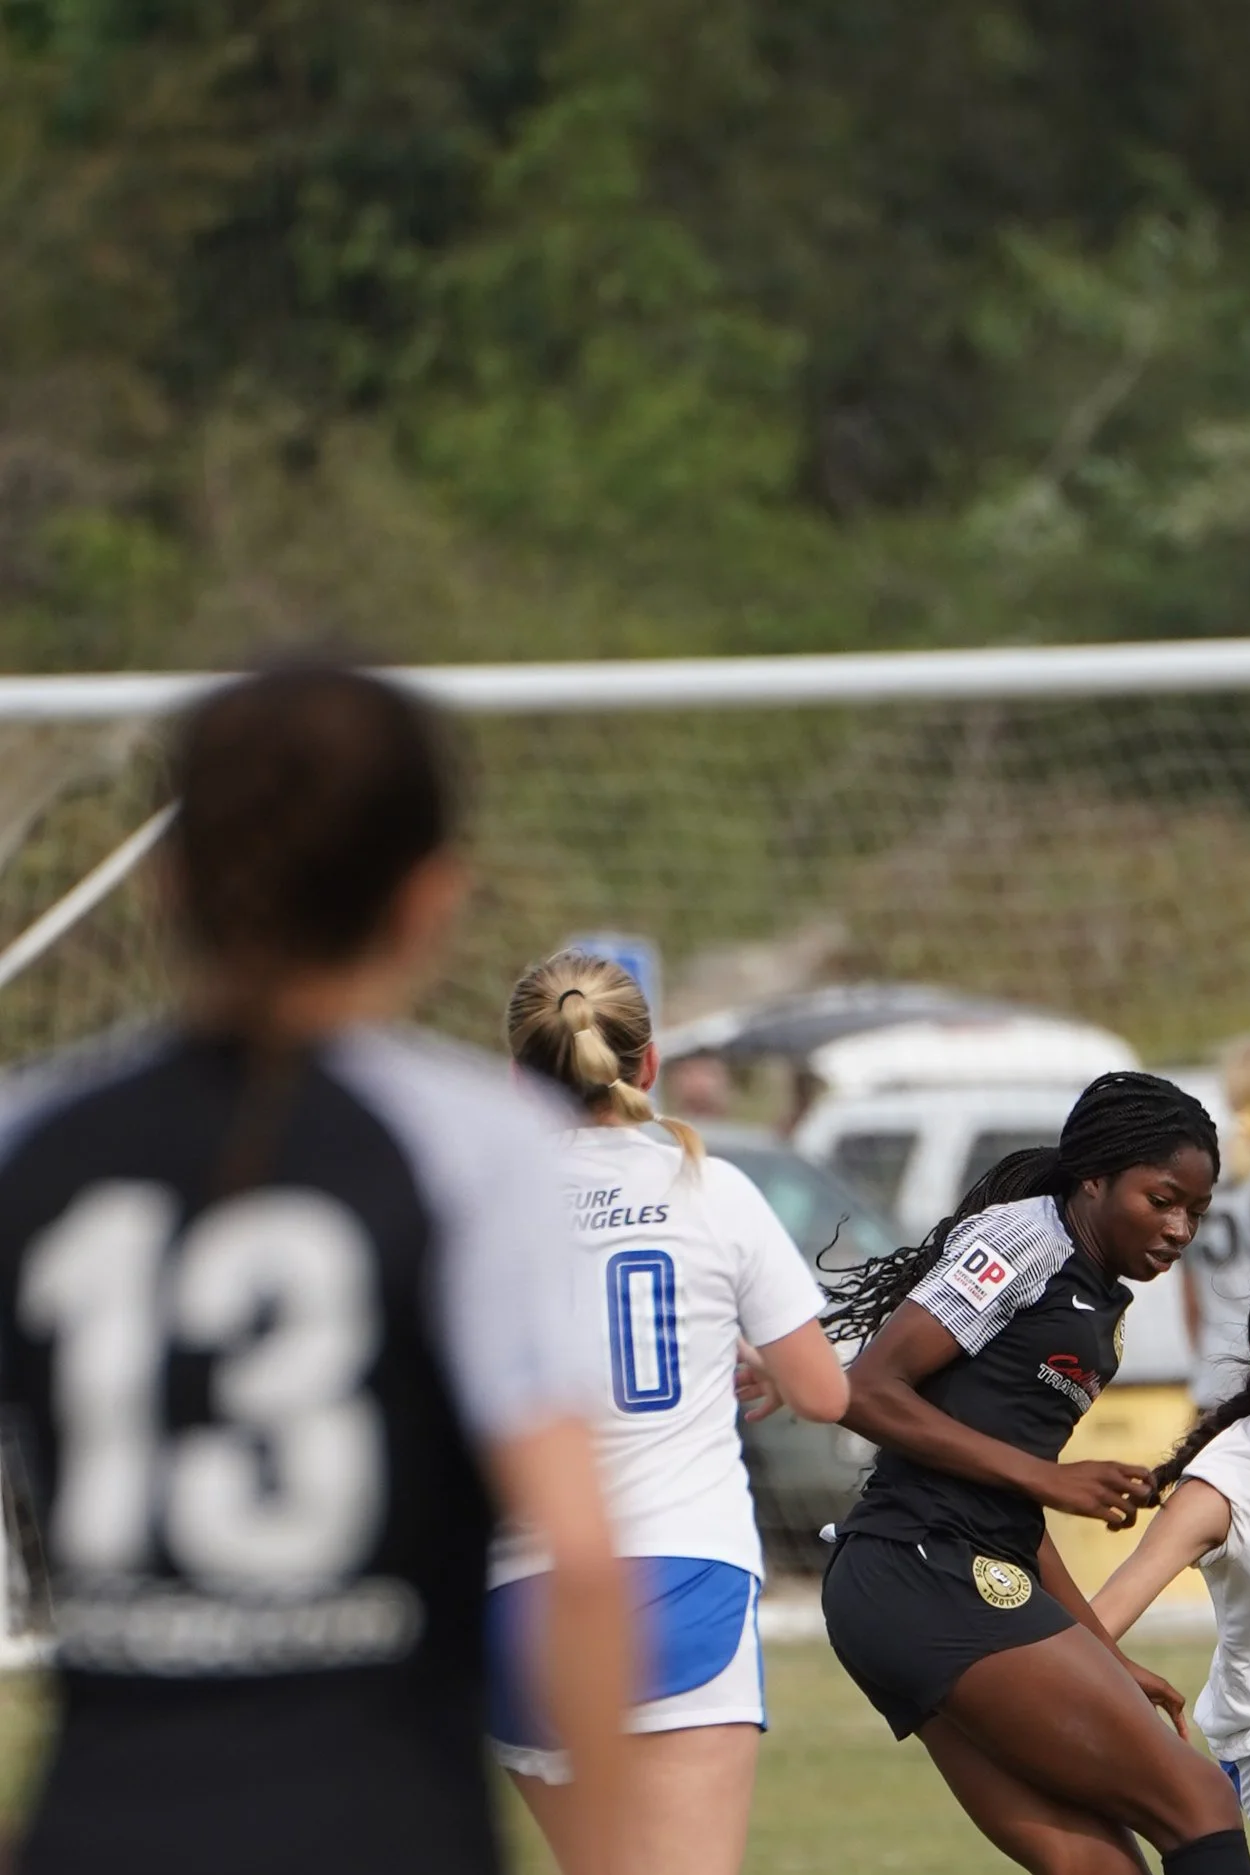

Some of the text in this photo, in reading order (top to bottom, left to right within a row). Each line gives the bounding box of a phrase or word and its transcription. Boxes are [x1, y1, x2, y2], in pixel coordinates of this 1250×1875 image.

[570, 1204, 669, 1230] NGELES
[962, 1248, 1006, 1284] DP
[606, 1250, 682, 1413] 0
[20, 1180, 382, 1592] 13
